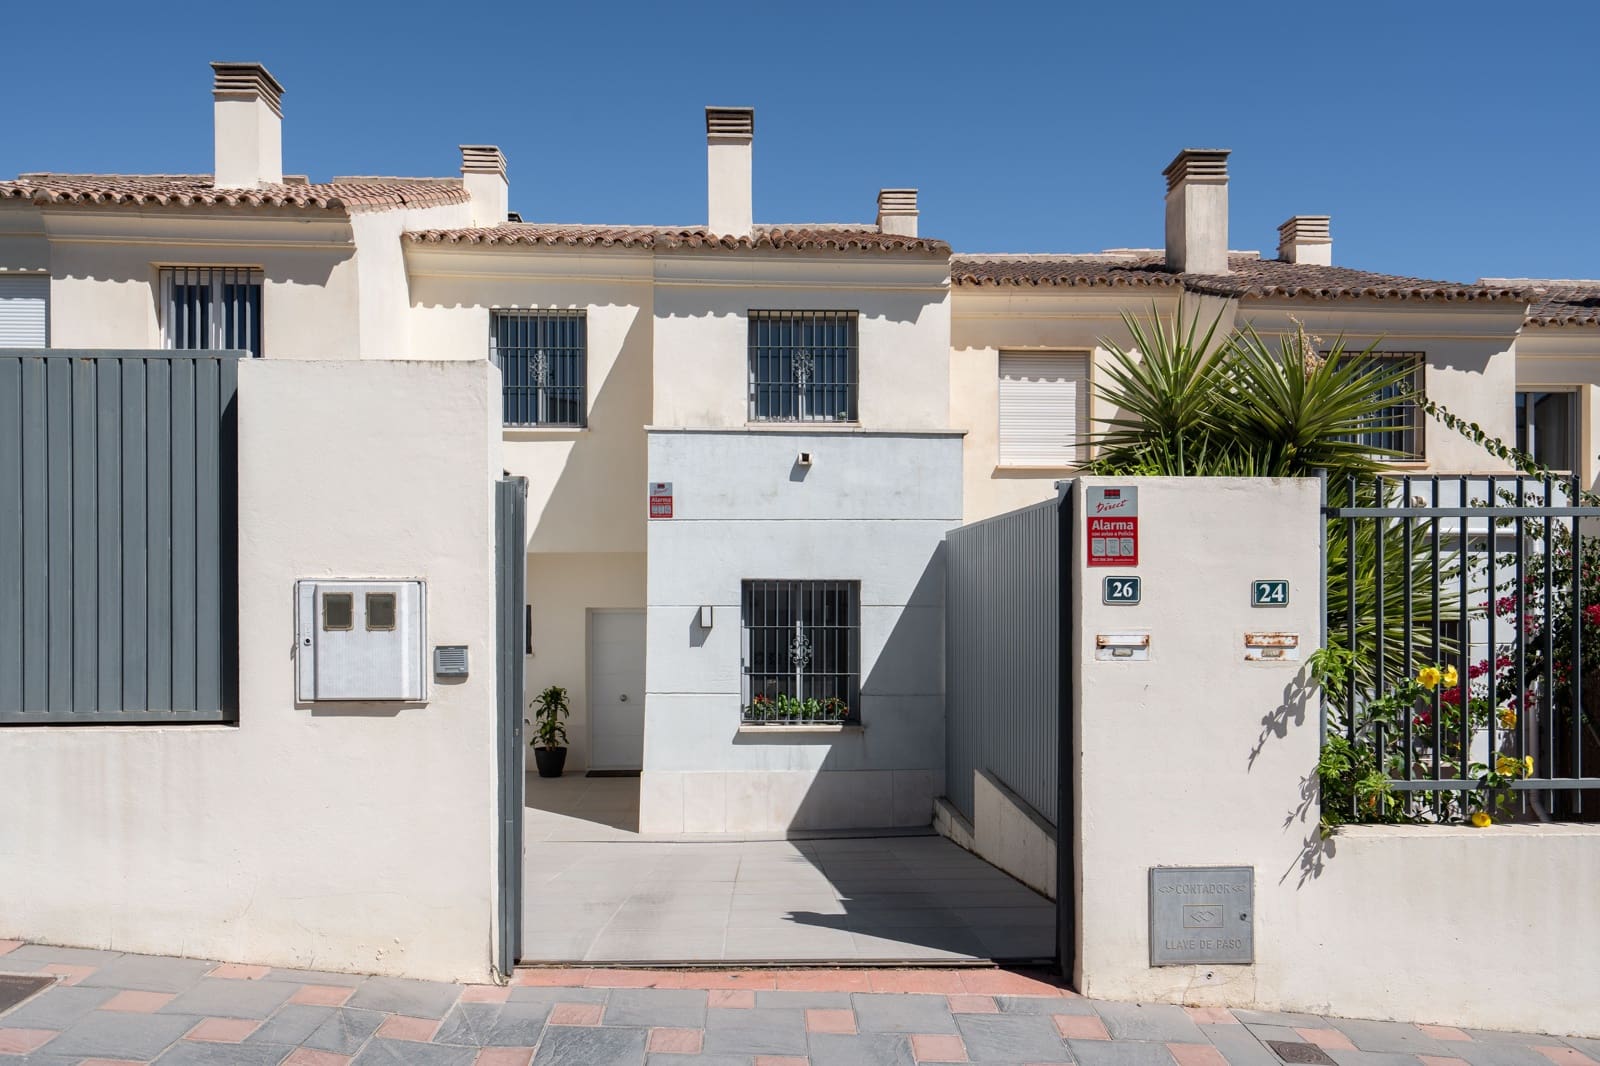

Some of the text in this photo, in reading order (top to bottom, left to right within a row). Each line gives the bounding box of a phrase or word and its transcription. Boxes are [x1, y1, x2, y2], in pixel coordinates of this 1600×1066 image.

[1096, 499, 1128, 513] Direct
[1091, 519, 1134, 530] Alarma
[1112, 581, 1134, 598] 26
[1259, 583, 1285, 602] 24
[1175, 883, 1231, 895] CONTADOR
[1165, 938, 1242, 950] LLAVE DE PASO
